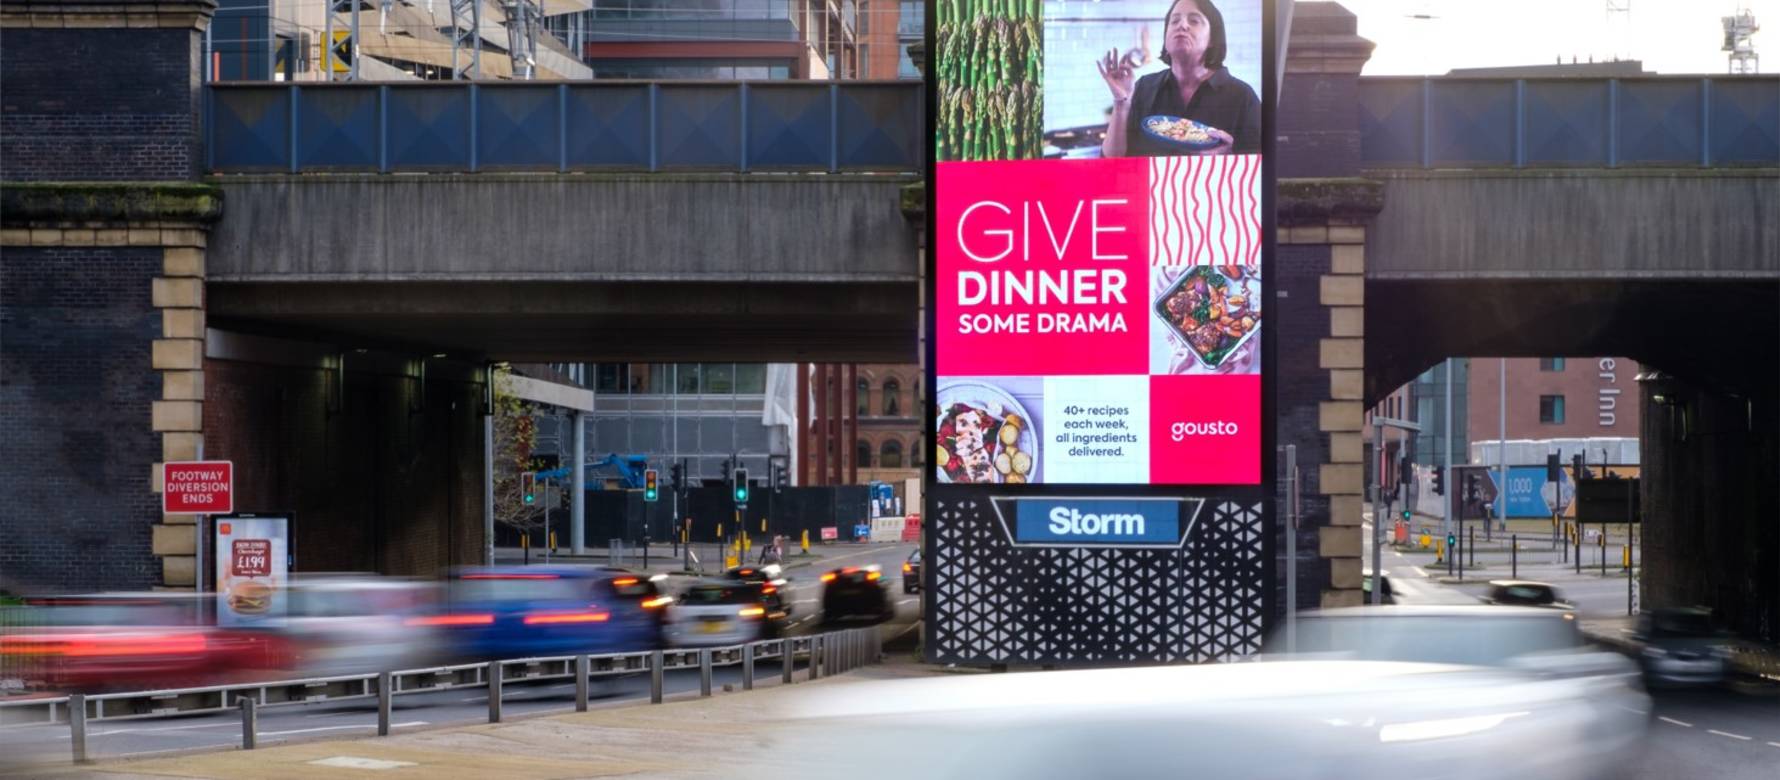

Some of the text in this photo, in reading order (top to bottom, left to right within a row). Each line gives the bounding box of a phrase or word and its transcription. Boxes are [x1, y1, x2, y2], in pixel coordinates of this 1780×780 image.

[957, 199, 1128, 262] GIVE
[958, 269, 1127, 305] DINNER
[958, 312, 1128, 333] SOME DRAMA
[1063, 405, 1129, 417] 40+ recipes
[1600, 389, 1620, 425] Inn
[1063, 419, 1129, 430] each week,
[1171, 420, 1239, 442] gousto
[1056, 433, 1137, 445] all ingredients
[1068, 446, 1124, 457] delivered.
[171, 471, 223, 481] FOOTWAY
[167, 482, 228, 492] DIVERSION
[182, 493, 213, 503] ENDS
[1048, 506, 1145, 535] Storm
